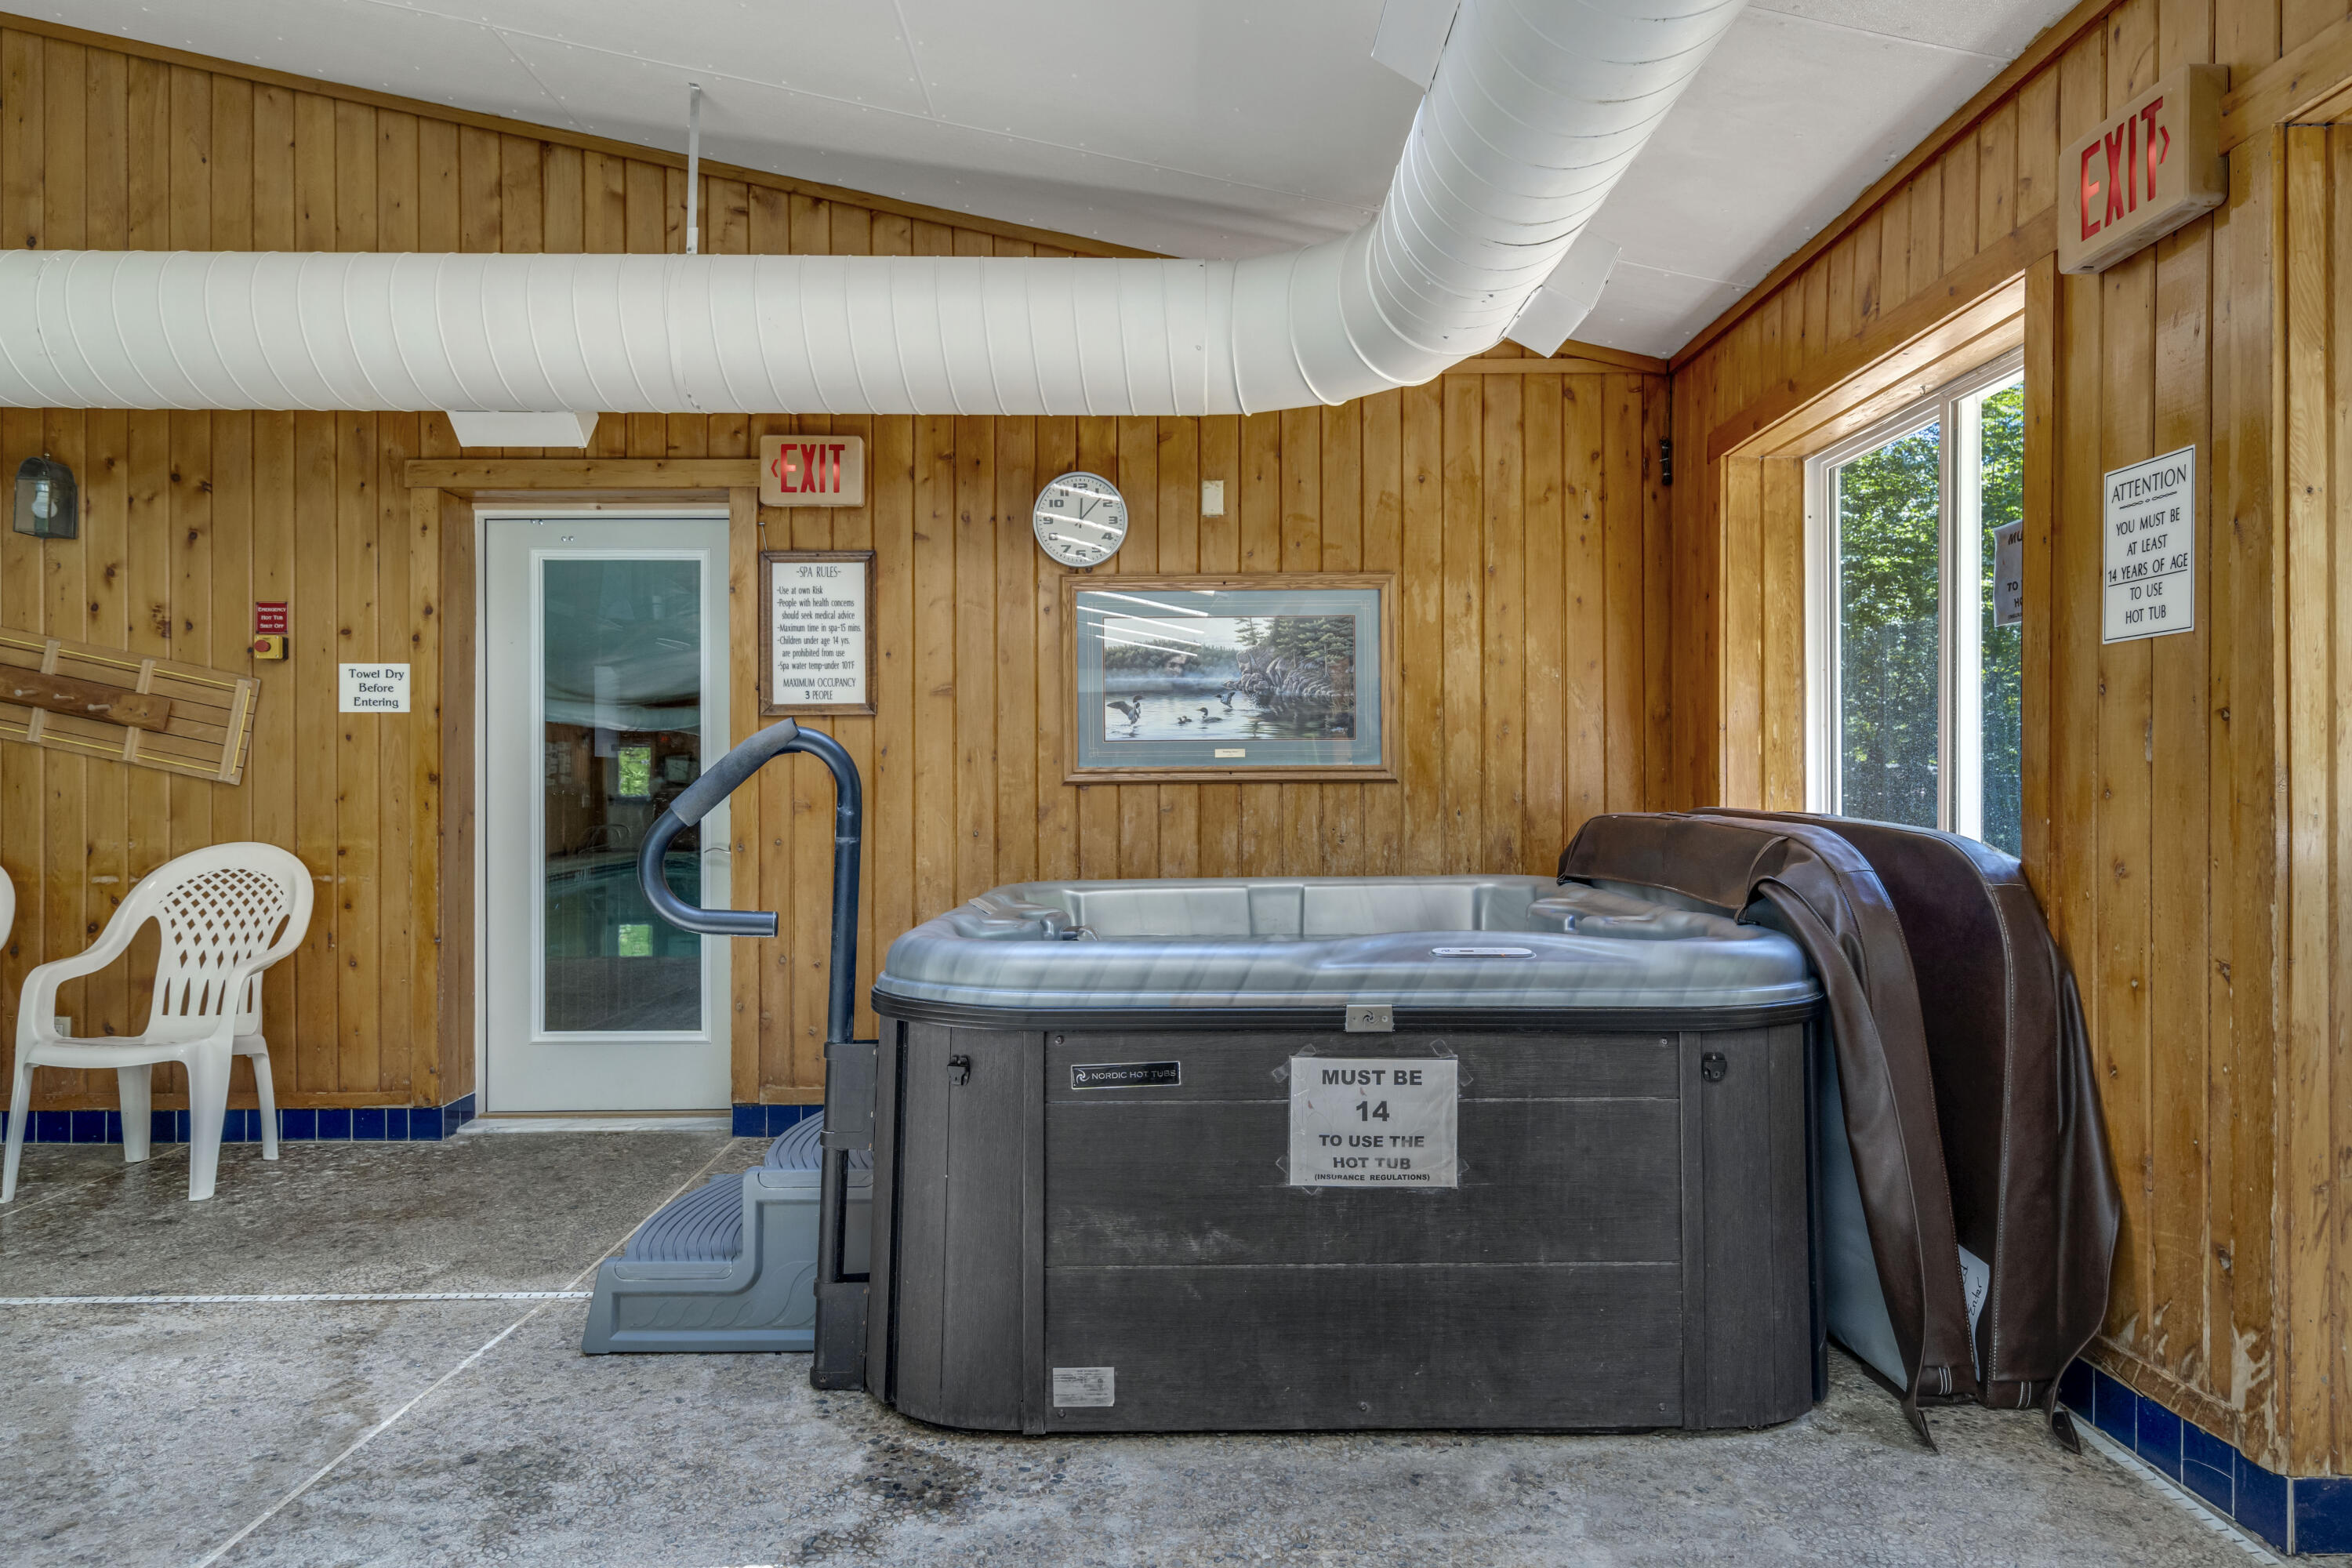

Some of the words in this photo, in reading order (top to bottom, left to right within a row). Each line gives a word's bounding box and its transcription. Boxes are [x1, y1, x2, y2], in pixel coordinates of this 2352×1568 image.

[2082, 96, 2164, 242] EXIT
[780, 444, 845, 493] EXIT
[2111, 464, 2187, 504] ATTENTION
[1049, 499, 1064, 508] 10
[1102, 499, 1113, 507] 2
[1109, 516, 1118, 524] 3
[2116, 518, 2135, 536] YOU
[2140, 511, 2165, 532] MUST
[2170, 507, 2180, 523] BE
[1102, 532, 1113, 541] 4
[2008, 530, 2023, 546] MU
[1061, 544, 1071, 554] 7
[2127, 541, 2137, 557] AT
[2142, 534, 2168, 554] LEAST
[2108, 569, 2117, 583] 14
[2122, 562, 2147, 580] YEARS
[2152, 558, 2165, 574] OF
[2170, 553, 2188, 570] AGE
[790, 586, 797, 595] at
[812, 586, 823, 594] Risk
[2007, 581, 2019, 593] TO
[2129, 586, 2141, 601] TO
[2147, 582, 2163, 598] USE
[799, 598, 811, 608] with
[812, 598, 829, 608] health
[782, 611, 799, 619] should
[800, 611, 813, 619] seek
[815, 611, 836, 619] medical
[837, 611, 855, 619] advice
[2125, 609, 2144, 625] HOT
[2149, 604, 2166, 621] TUB
[807, 623, 819, 632] time
[821, 623, 827, 632] in
[804, 636, 818, 644] under
[820, 637, 830, 647] age
[833, 636, 839, 644] 14
[793, 648, 820, 659] prohibited
[822, 648, 834, 657] from
[791, 662, 807, 670] water
[348, 669, 380, 679] Towel
[385, 669, 405, 681] Dry
[359, 683, 394, 693] Before
[782, 678, 815, 688] MAXIMUM
[817, 678, 856, 688] OCCUPANCY
[804, 691, 811, 699] 3
[812, 690, 833, 699] PEOPLE
[354, 697, 399, 709] Entering
[1322, 1069, 1385, 1086] MUST
[1393, 1069, 1422, 1086] BE
[1356, 1101, 1390, 1122] 14
[1319, 1134, 1343, 1147] TO
[1348, 1135, 1384, 1148] USE
[1389, 1136, 1425, 1148] THE
[1333, 1156, 1369, 1168] HOT
[1374, 1157, 1411, 1170] TUB
